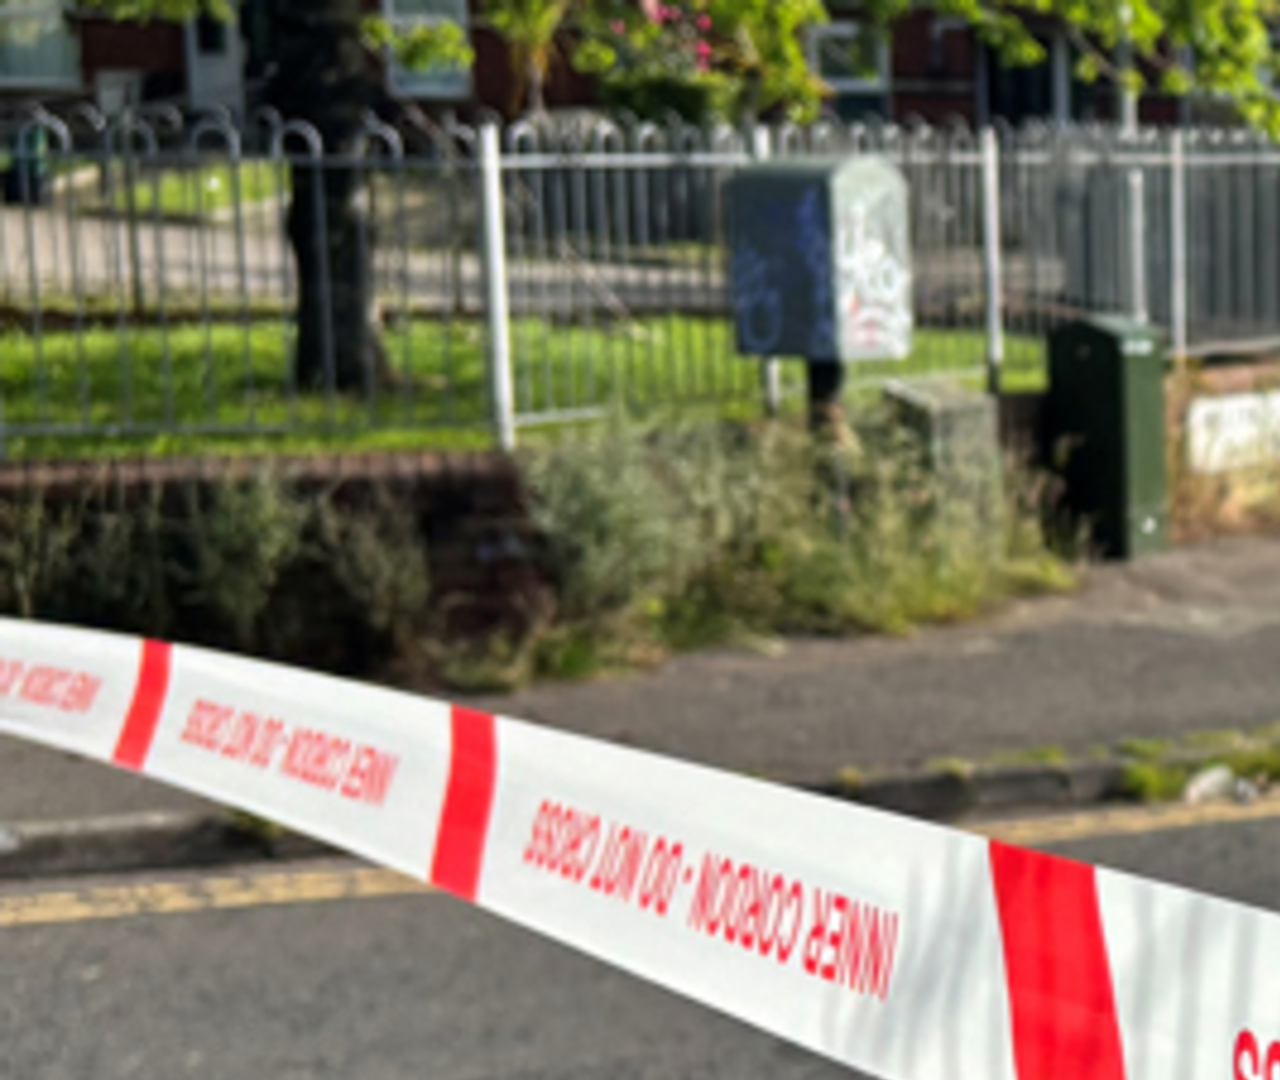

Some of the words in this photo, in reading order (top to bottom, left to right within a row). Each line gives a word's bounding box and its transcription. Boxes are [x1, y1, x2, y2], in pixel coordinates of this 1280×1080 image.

[523, 799, 602, 884] CROSS
[589, 820, 648, 903] NOT
[638, 836, 683, 917] DO
[687, 851, 804, 964] CORDON
[802, 887, 899, 1002] INNER
